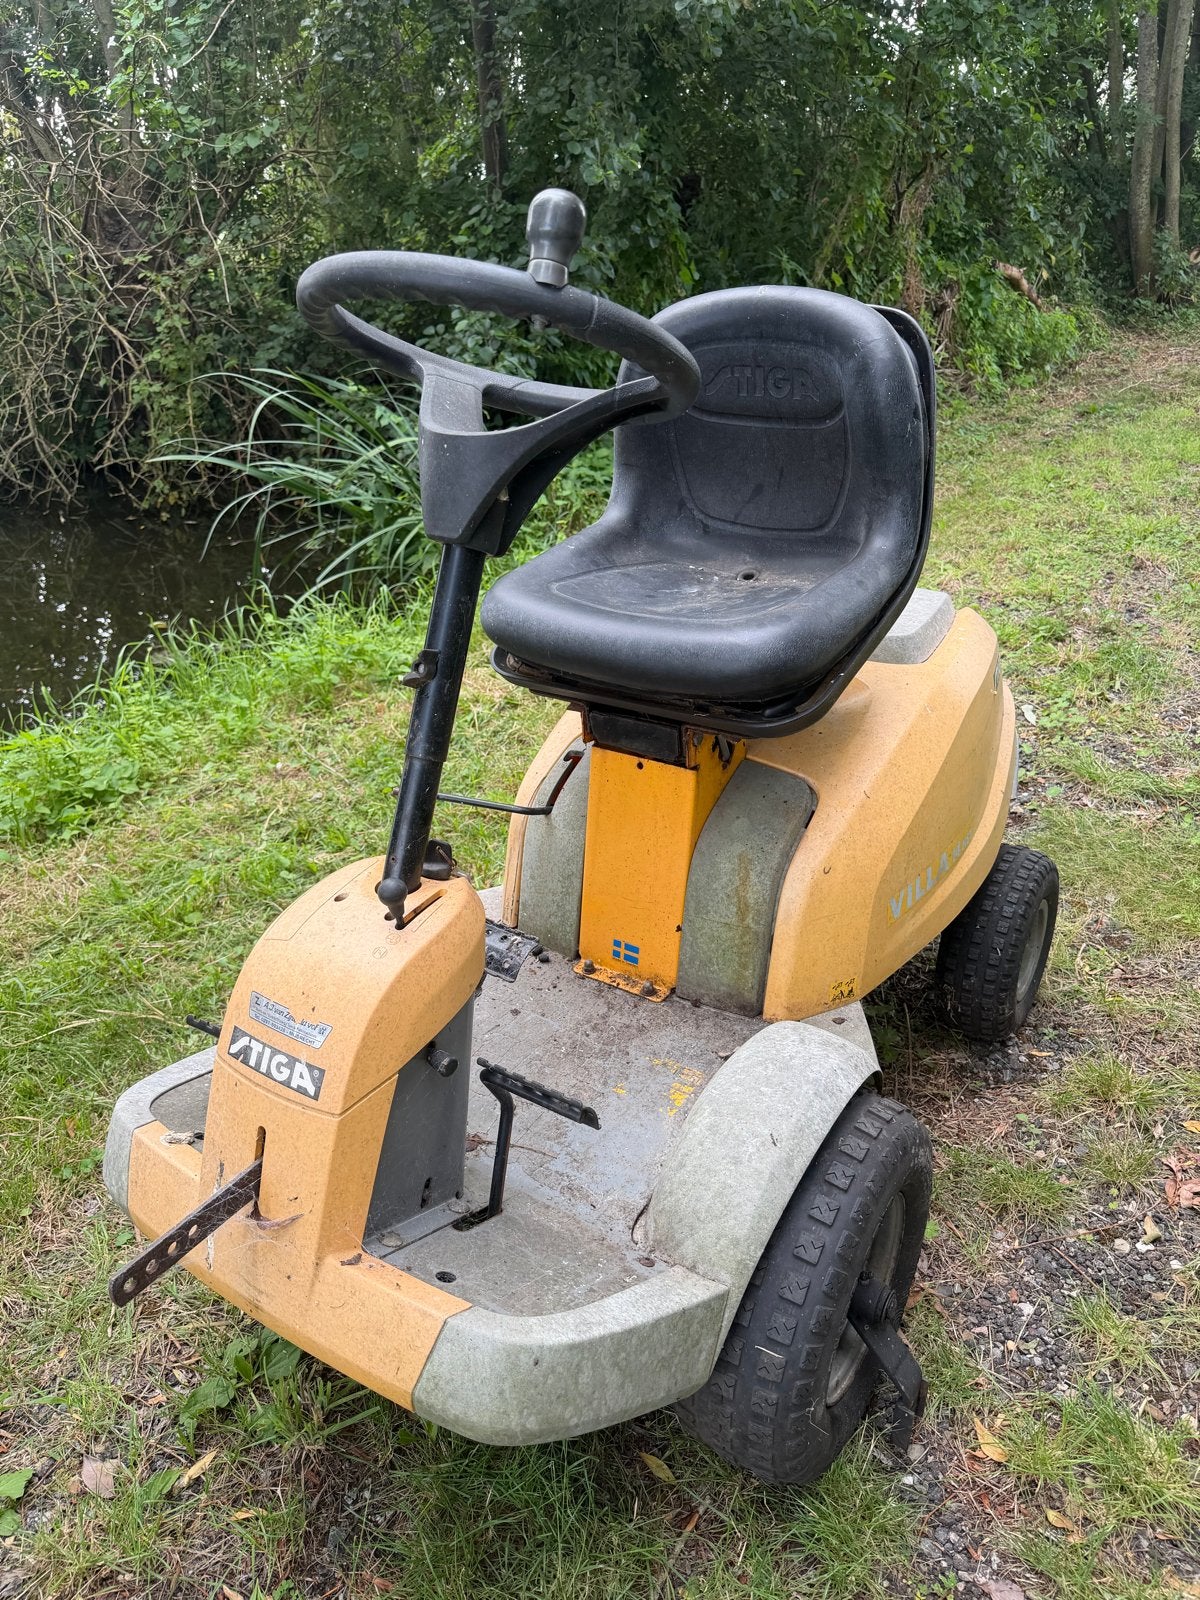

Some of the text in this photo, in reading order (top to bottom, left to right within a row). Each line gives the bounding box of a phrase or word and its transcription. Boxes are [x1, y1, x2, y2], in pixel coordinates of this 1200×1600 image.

[704, 365, 820, 402] STIGA
[890, 850, 949, 919] VILLA
[229, 1036, 316, 1097] STIGA
